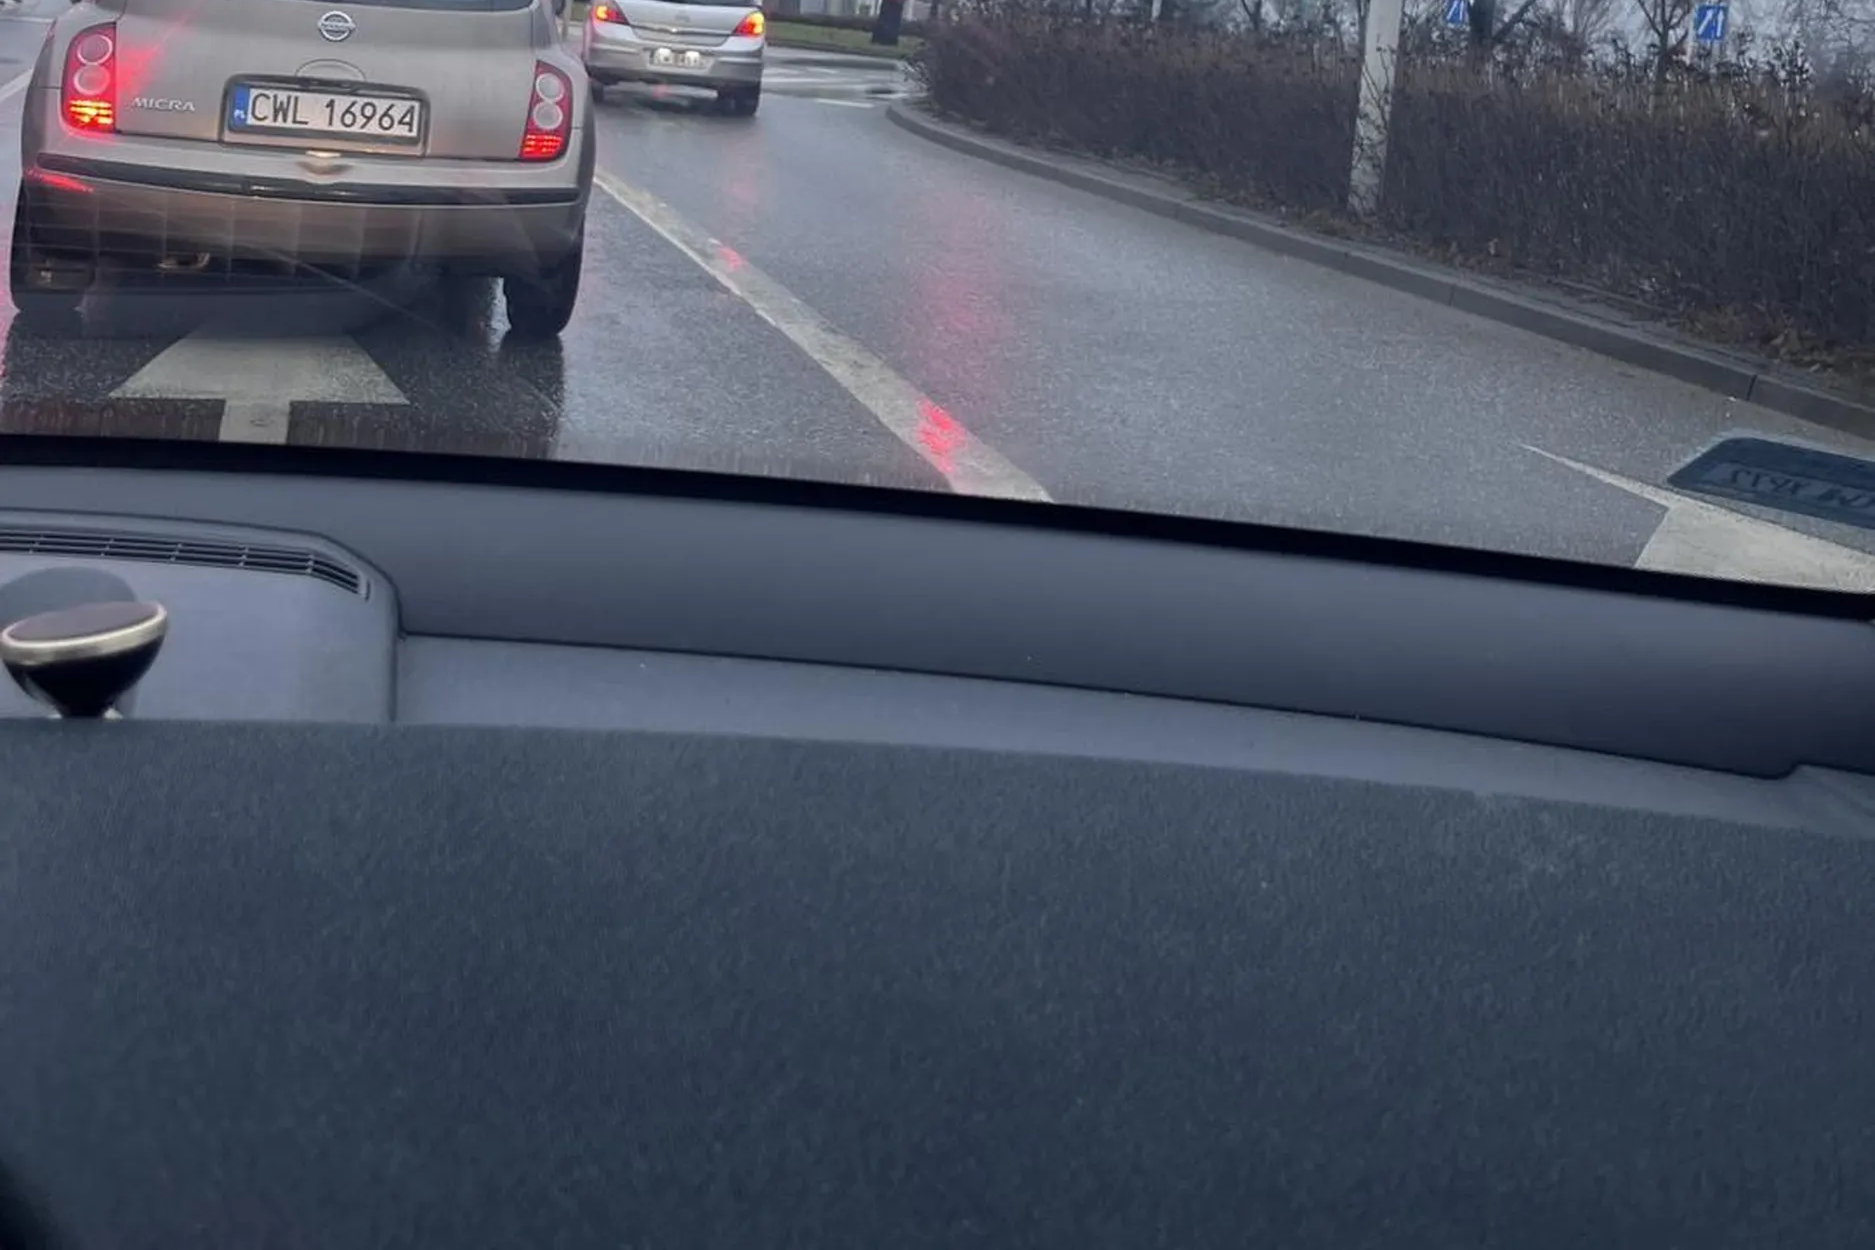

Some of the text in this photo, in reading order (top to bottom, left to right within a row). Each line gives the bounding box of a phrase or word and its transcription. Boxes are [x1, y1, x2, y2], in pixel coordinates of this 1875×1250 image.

[130, 96, 195, 112] MICRA
[250, 93, 416, 133] CWL 16964
